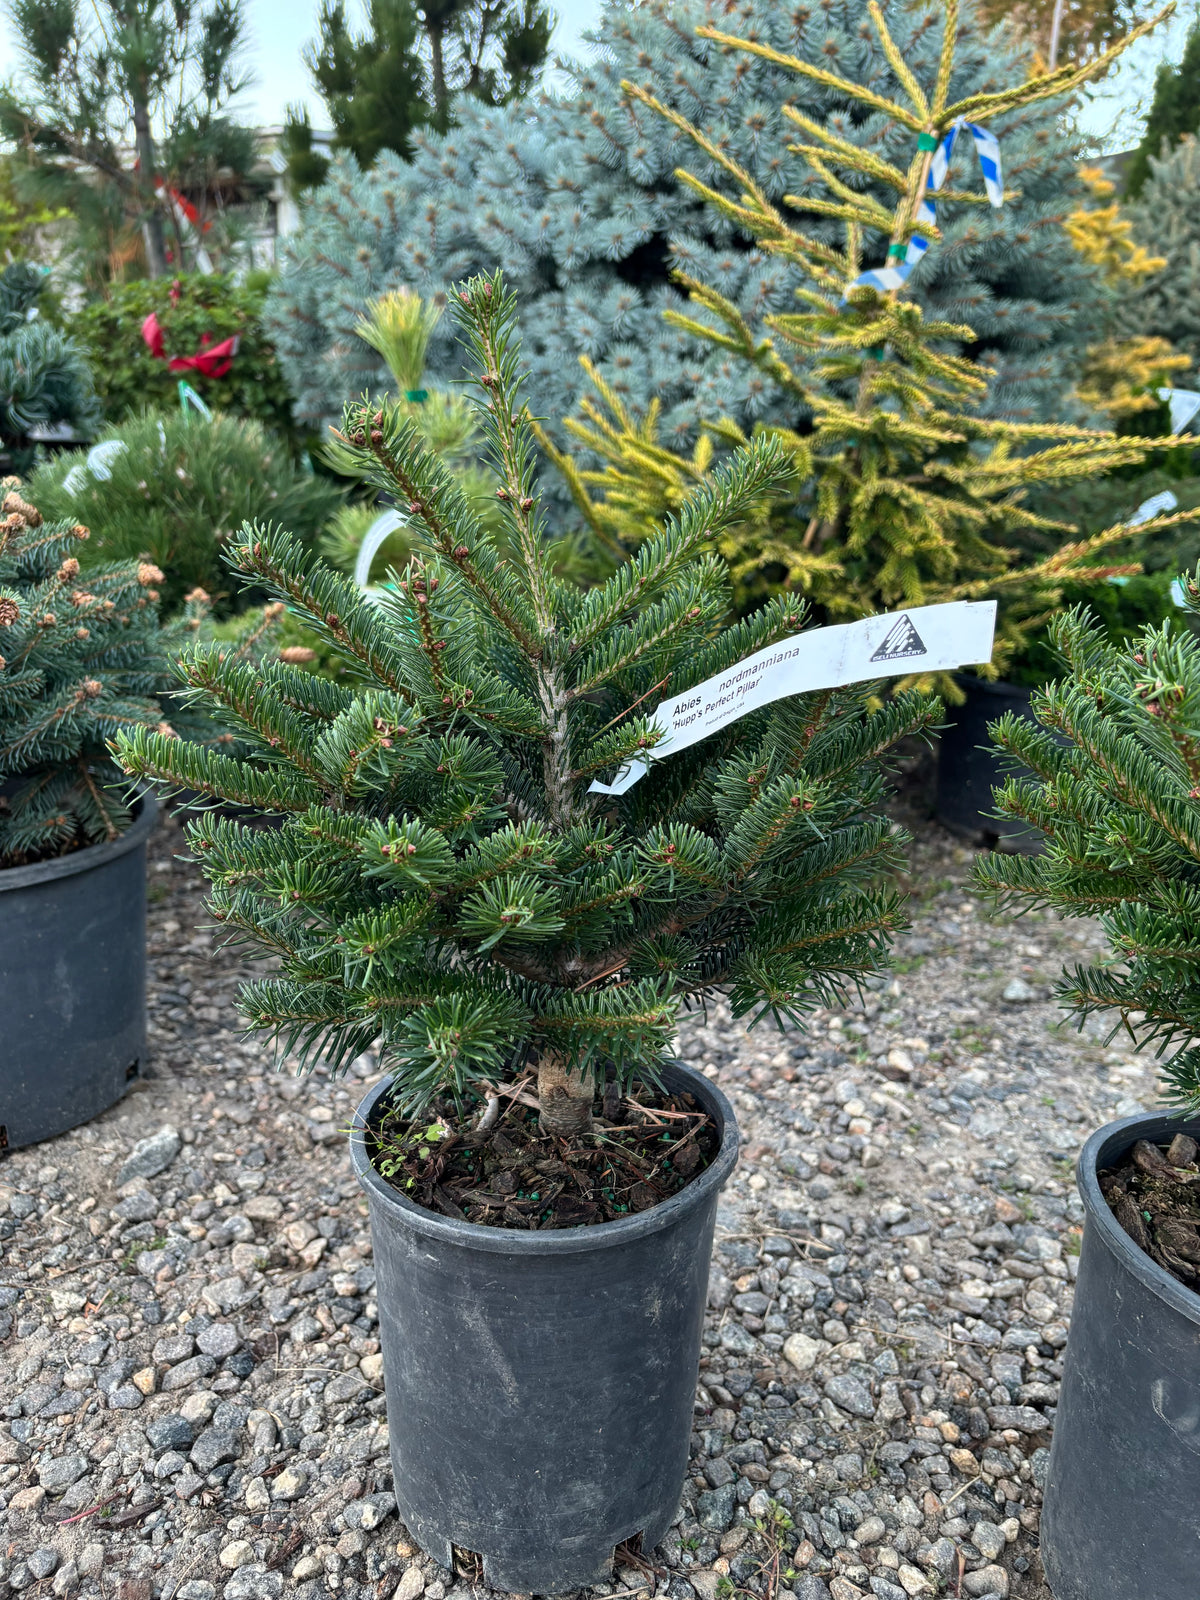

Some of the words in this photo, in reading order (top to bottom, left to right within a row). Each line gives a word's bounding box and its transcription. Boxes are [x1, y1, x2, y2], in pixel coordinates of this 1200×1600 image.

[672, 695, 702, 717] Abies
[719, 647, 800, 693] nordmanniana
[704, 692, 735, 714] Perfect
